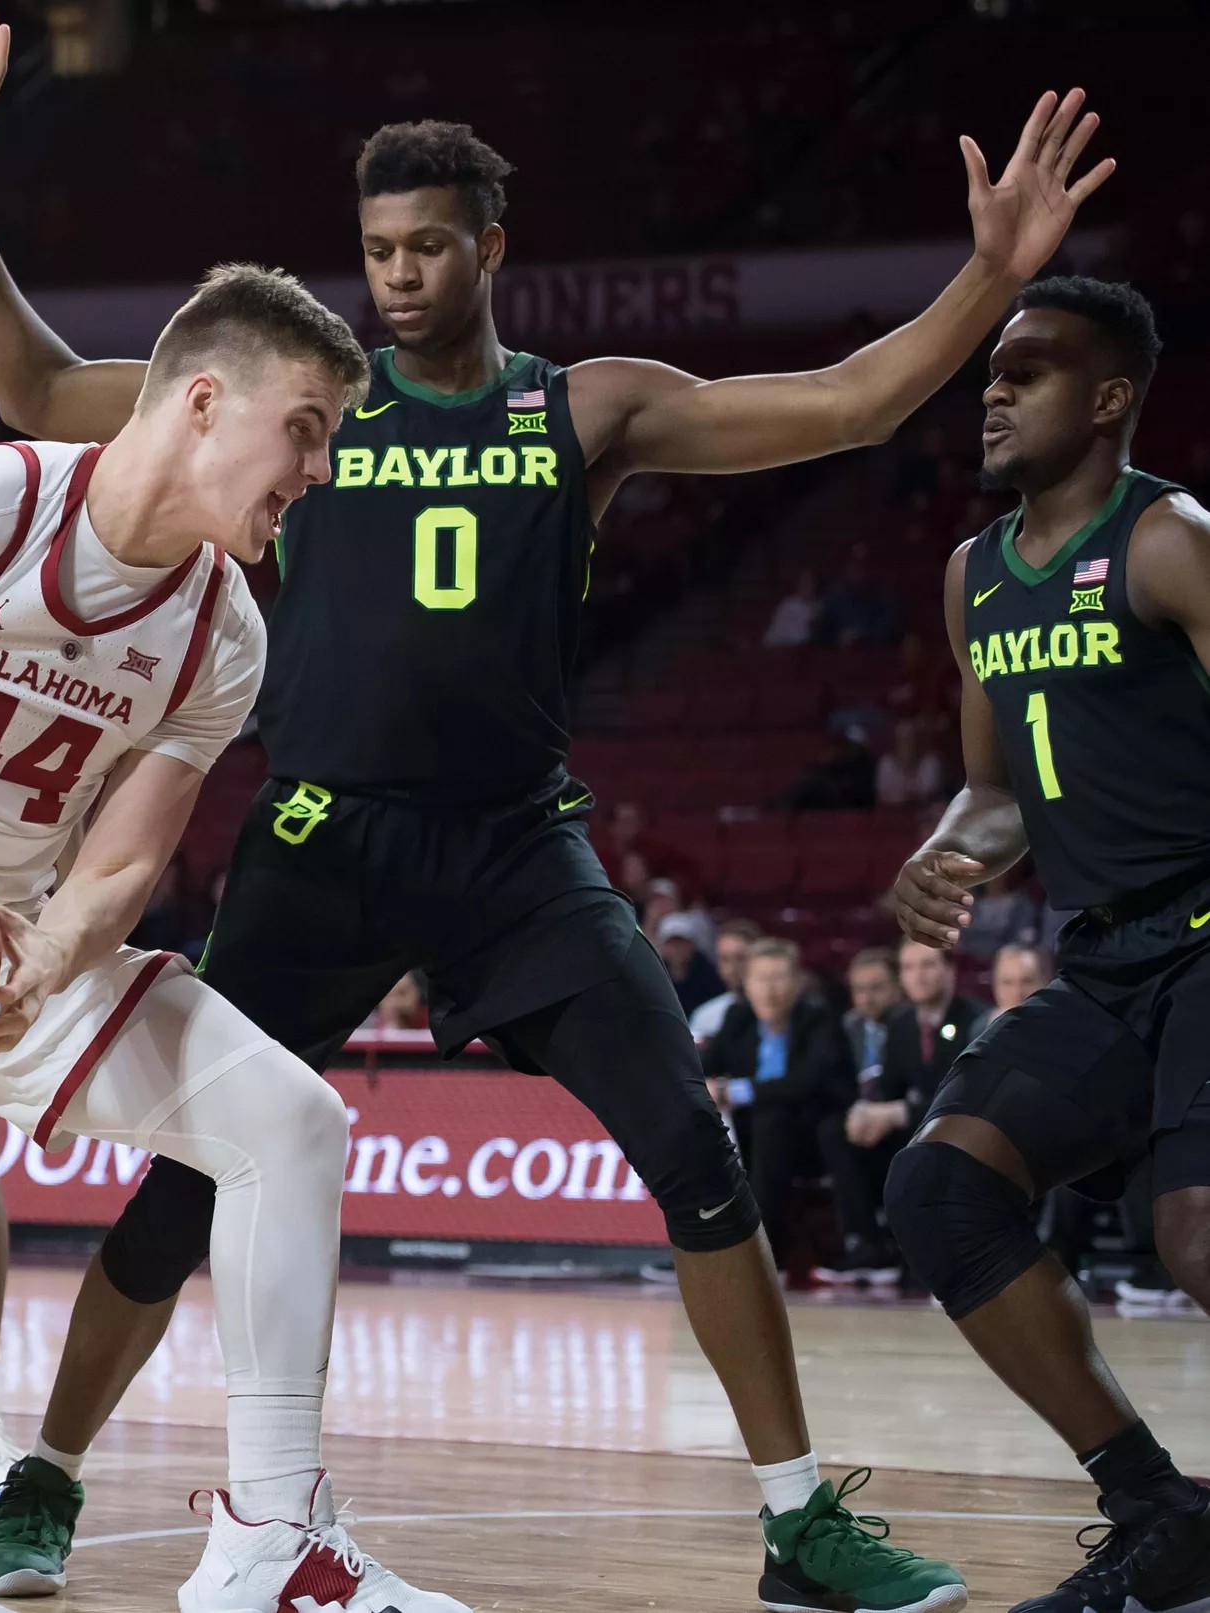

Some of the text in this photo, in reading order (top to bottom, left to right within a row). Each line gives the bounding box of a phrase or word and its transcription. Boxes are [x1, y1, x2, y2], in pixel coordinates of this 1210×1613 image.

[499, 261, 740, 338] ONERS
[335, 446, 558, 488] BAYLOR
[413, 506, 478, 610] 0
[969, 621, 1123, 684] BAYLOR
[1025, 691, 1063, 801] 1
